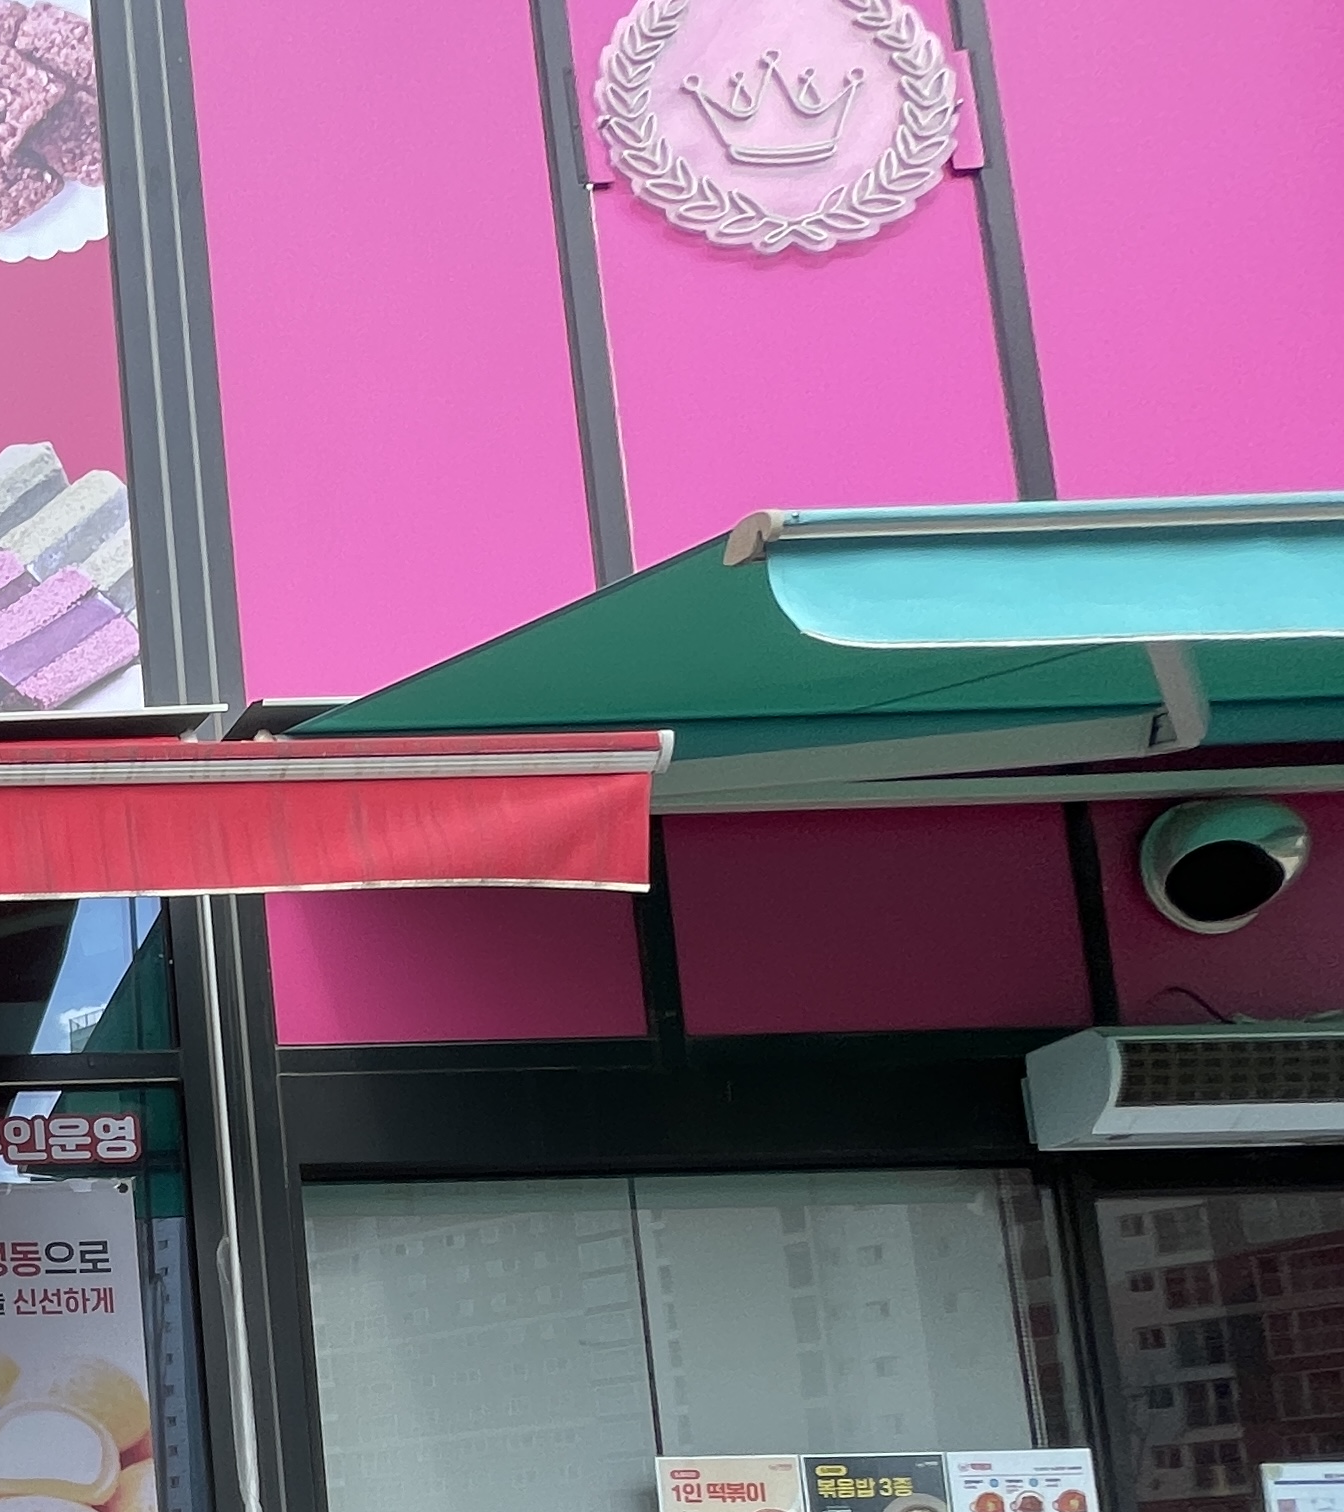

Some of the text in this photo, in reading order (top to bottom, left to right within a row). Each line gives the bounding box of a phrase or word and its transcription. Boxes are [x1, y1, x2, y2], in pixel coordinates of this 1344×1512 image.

[12, 1286, 116, 1317] 신선하게
[670, 1481, 767, 1504] 1인 떡볶이
[816, 1477, 875, 1499] 볶음밥
